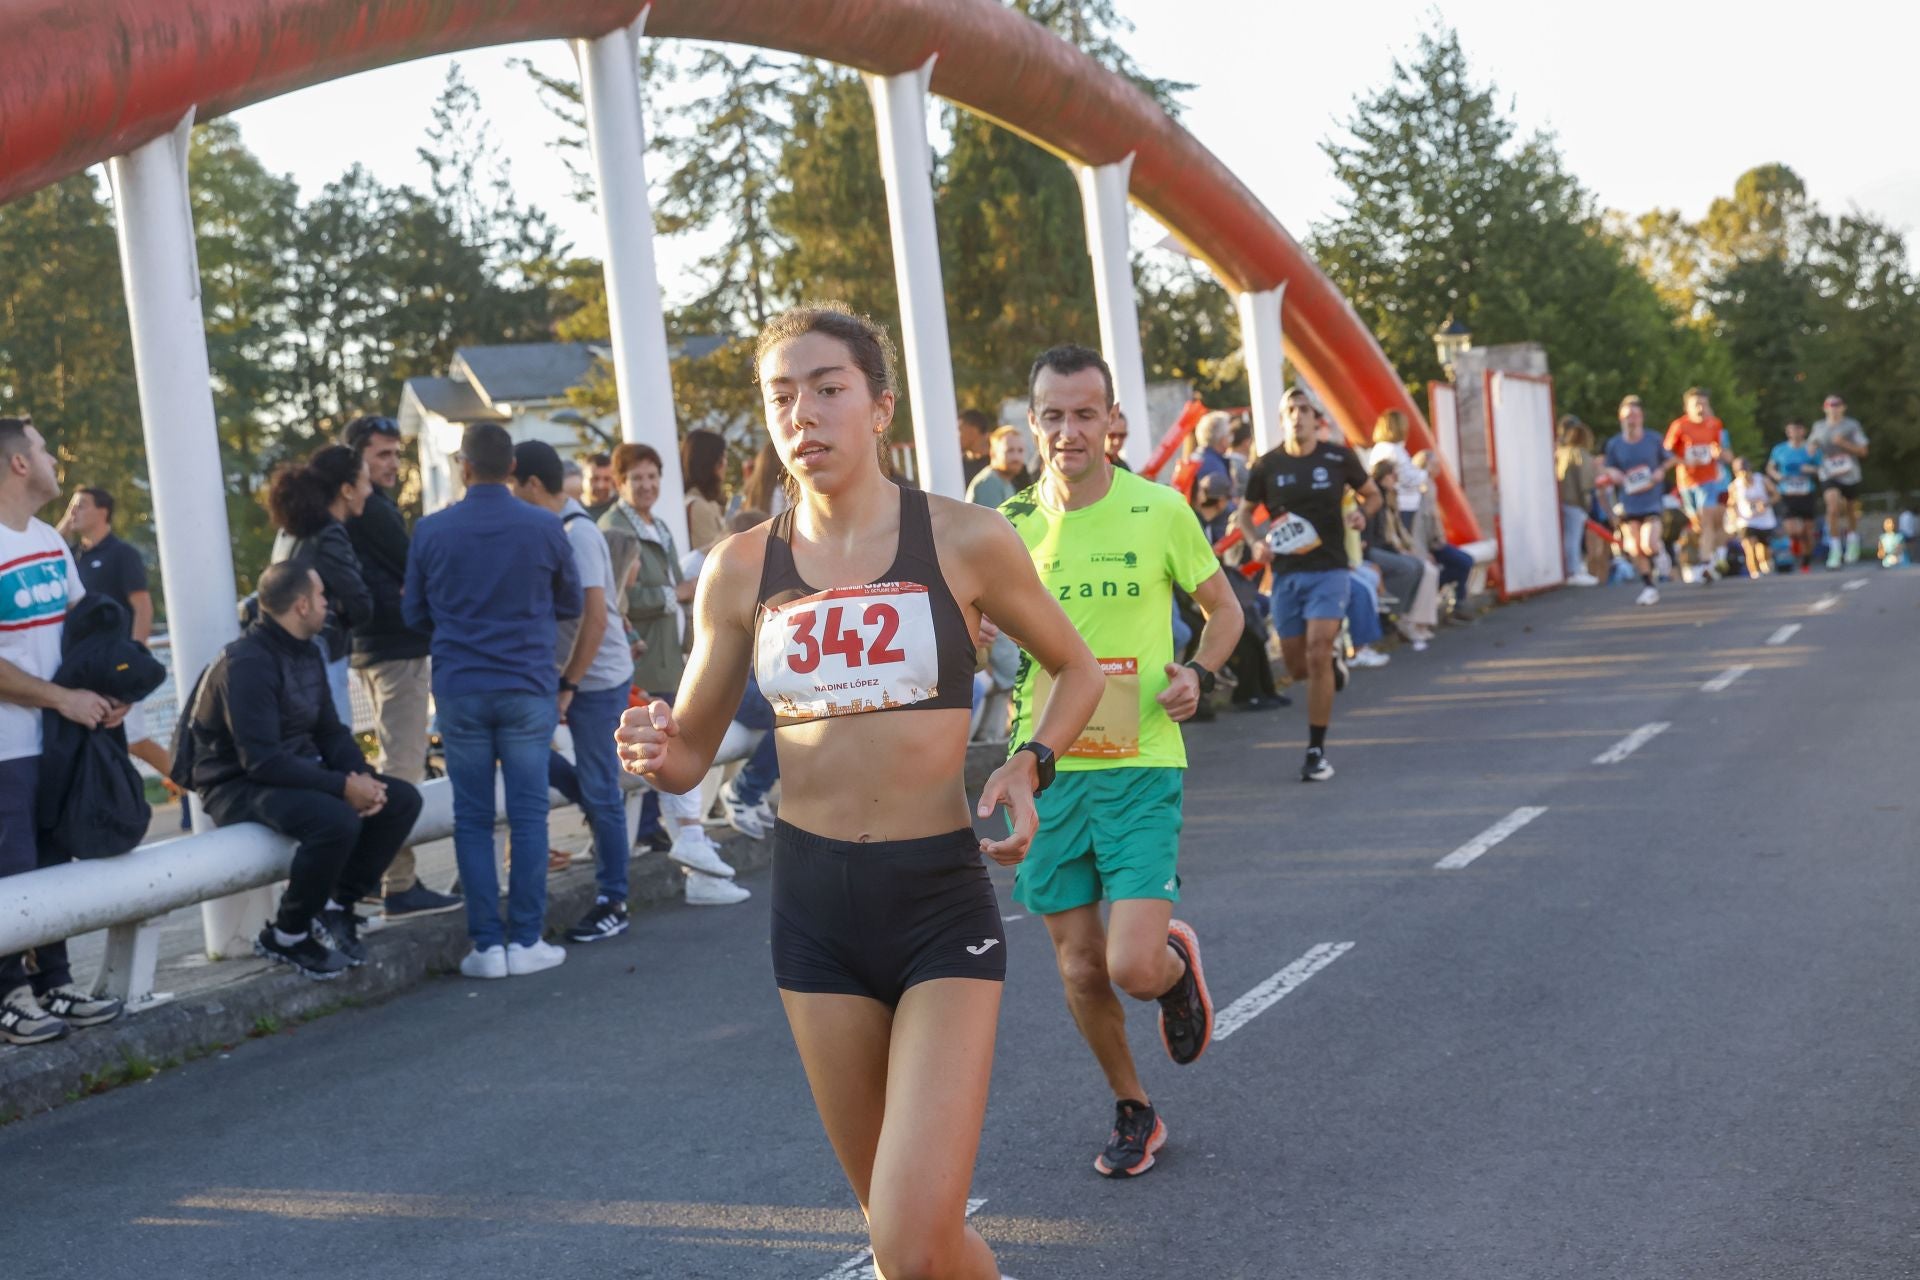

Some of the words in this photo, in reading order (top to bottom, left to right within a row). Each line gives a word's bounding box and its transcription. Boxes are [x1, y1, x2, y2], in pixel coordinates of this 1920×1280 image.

[1057, 581, 1140, 600] zana
[787, 603, 906, 674] 342
[814, 682, 849, 693] NADINE
[850, 678, 880, 689] LÓPEZ
